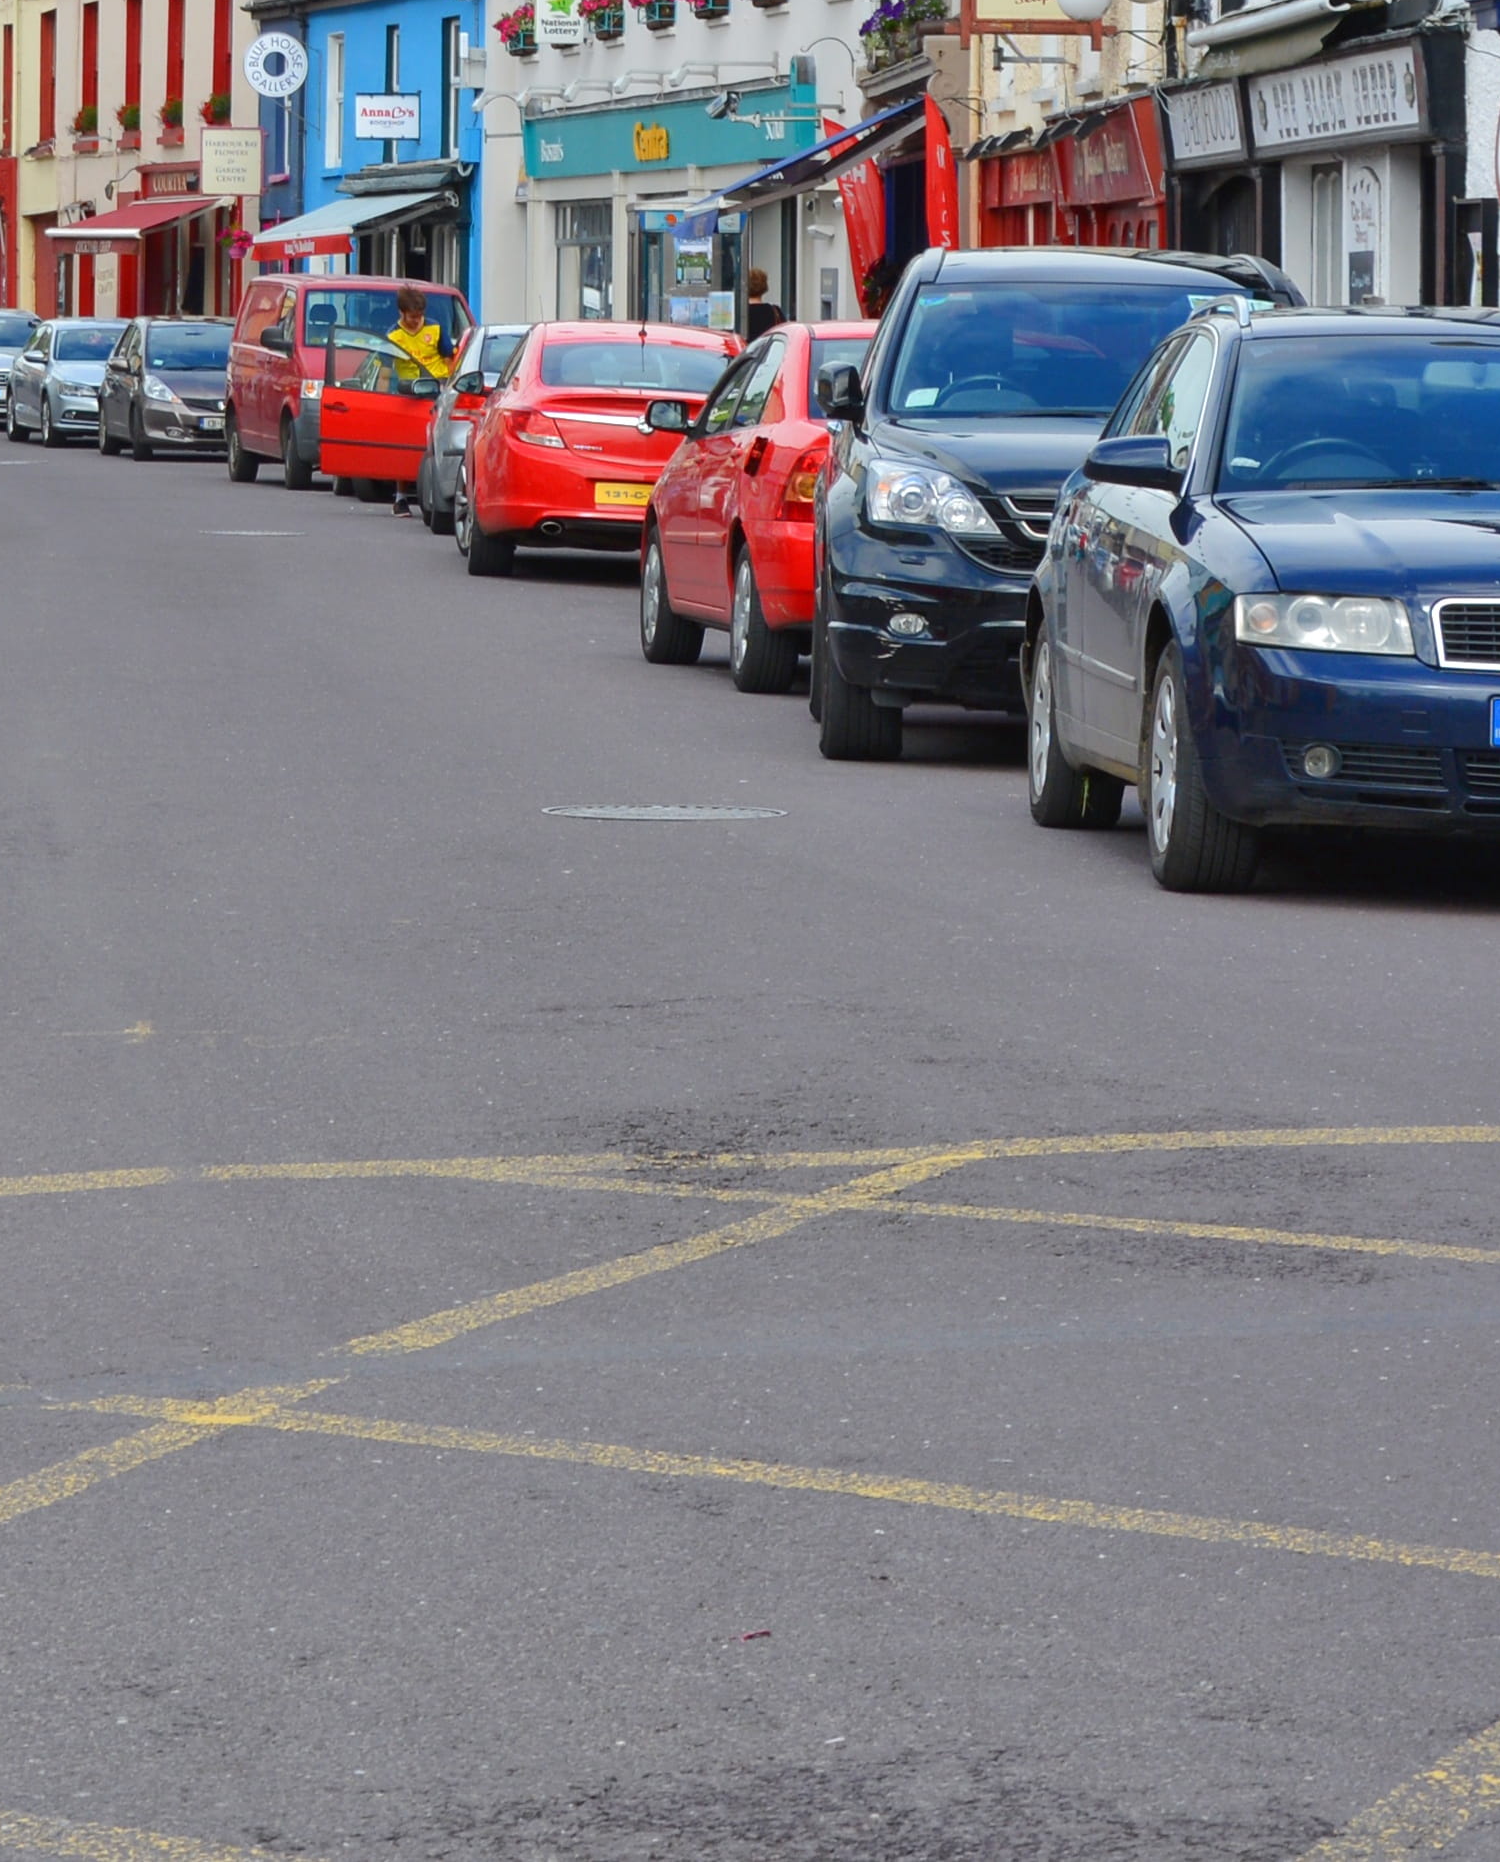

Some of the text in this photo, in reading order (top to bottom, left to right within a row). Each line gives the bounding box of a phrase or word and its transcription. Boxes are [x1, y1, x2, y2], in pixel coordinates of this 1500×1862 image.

[541, 18, 581, 27] National
[543, 27, 579, 36] Lottery
[249, 36, 303, 69] BLUE HOUSE
[251, 70, 299, 93] GALLERY
[1273, 82, 1299, 139] THE
[205, 140, 243, 148] HARBOUR
[215, 166, 247, 174] GARDEN
[216, 175, 246, 183] CENTRE
